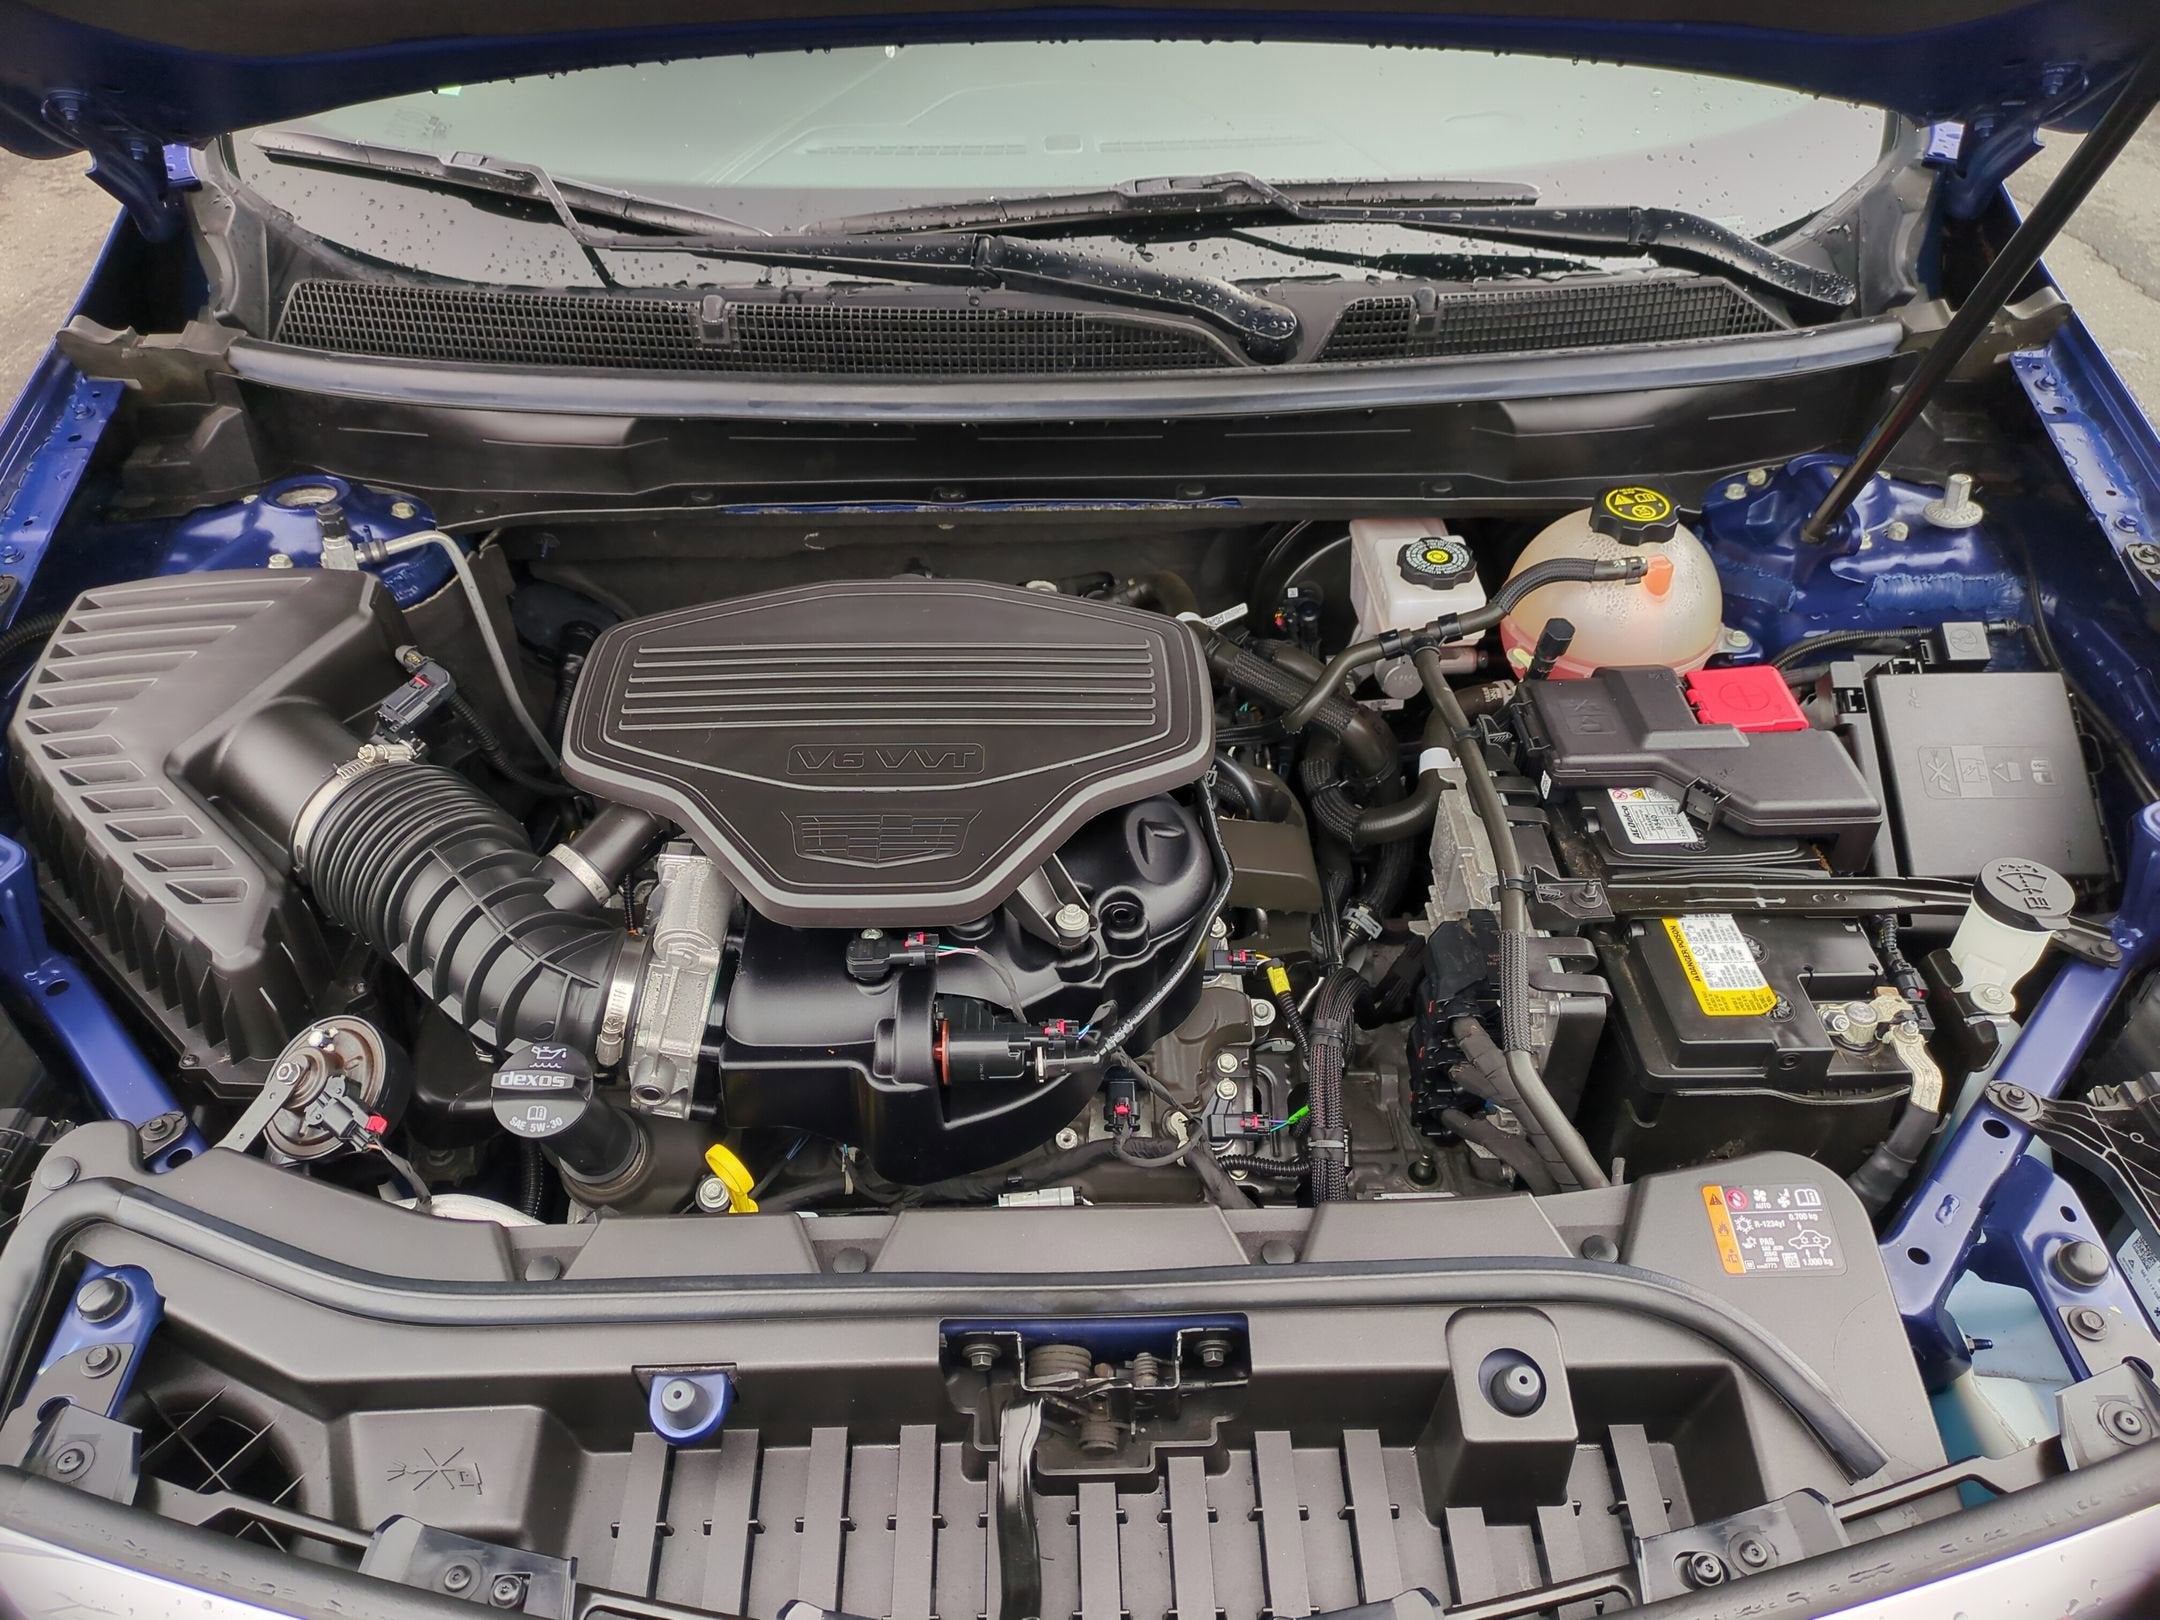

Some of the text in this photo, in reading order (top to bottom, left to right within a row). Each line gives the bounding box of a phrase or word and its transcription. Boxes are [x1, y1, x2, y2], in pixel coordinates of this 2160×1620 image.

[797, 749, 977, 769] V6 VVT
[1621, 804, 1641, 840] ACDelco
[500, 1071, 566, 1087] dexos
[509, 1116, 563, 1133] SAE 5W-30
[1759, 1237, 1775, 1245] PAG
